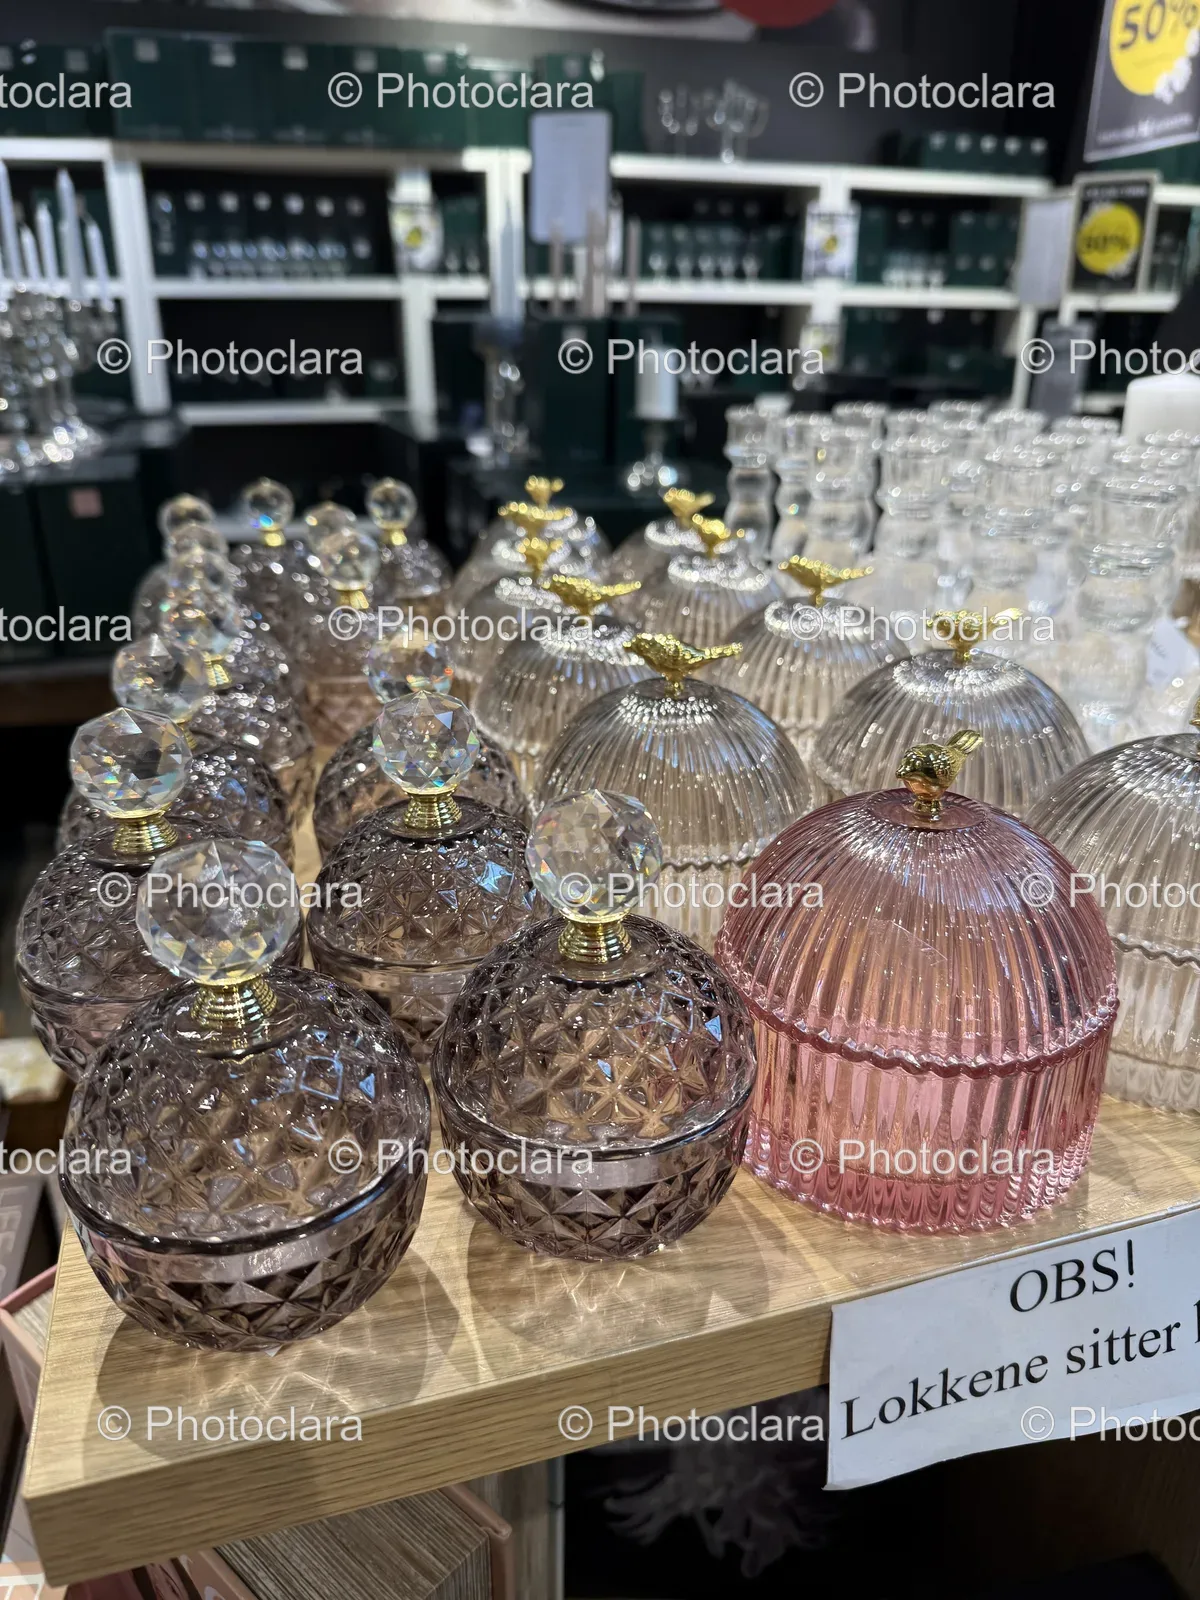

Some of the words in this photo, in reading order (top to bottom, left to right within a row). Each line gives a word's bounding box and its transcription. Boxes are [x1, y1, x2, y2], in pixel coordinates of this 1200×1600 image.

[1009, 1238, 1135, 1313] OBS!
[840, 1354, 1049, 1440] Lokkene
[1066, 1320, 1181, 1375] sitter
